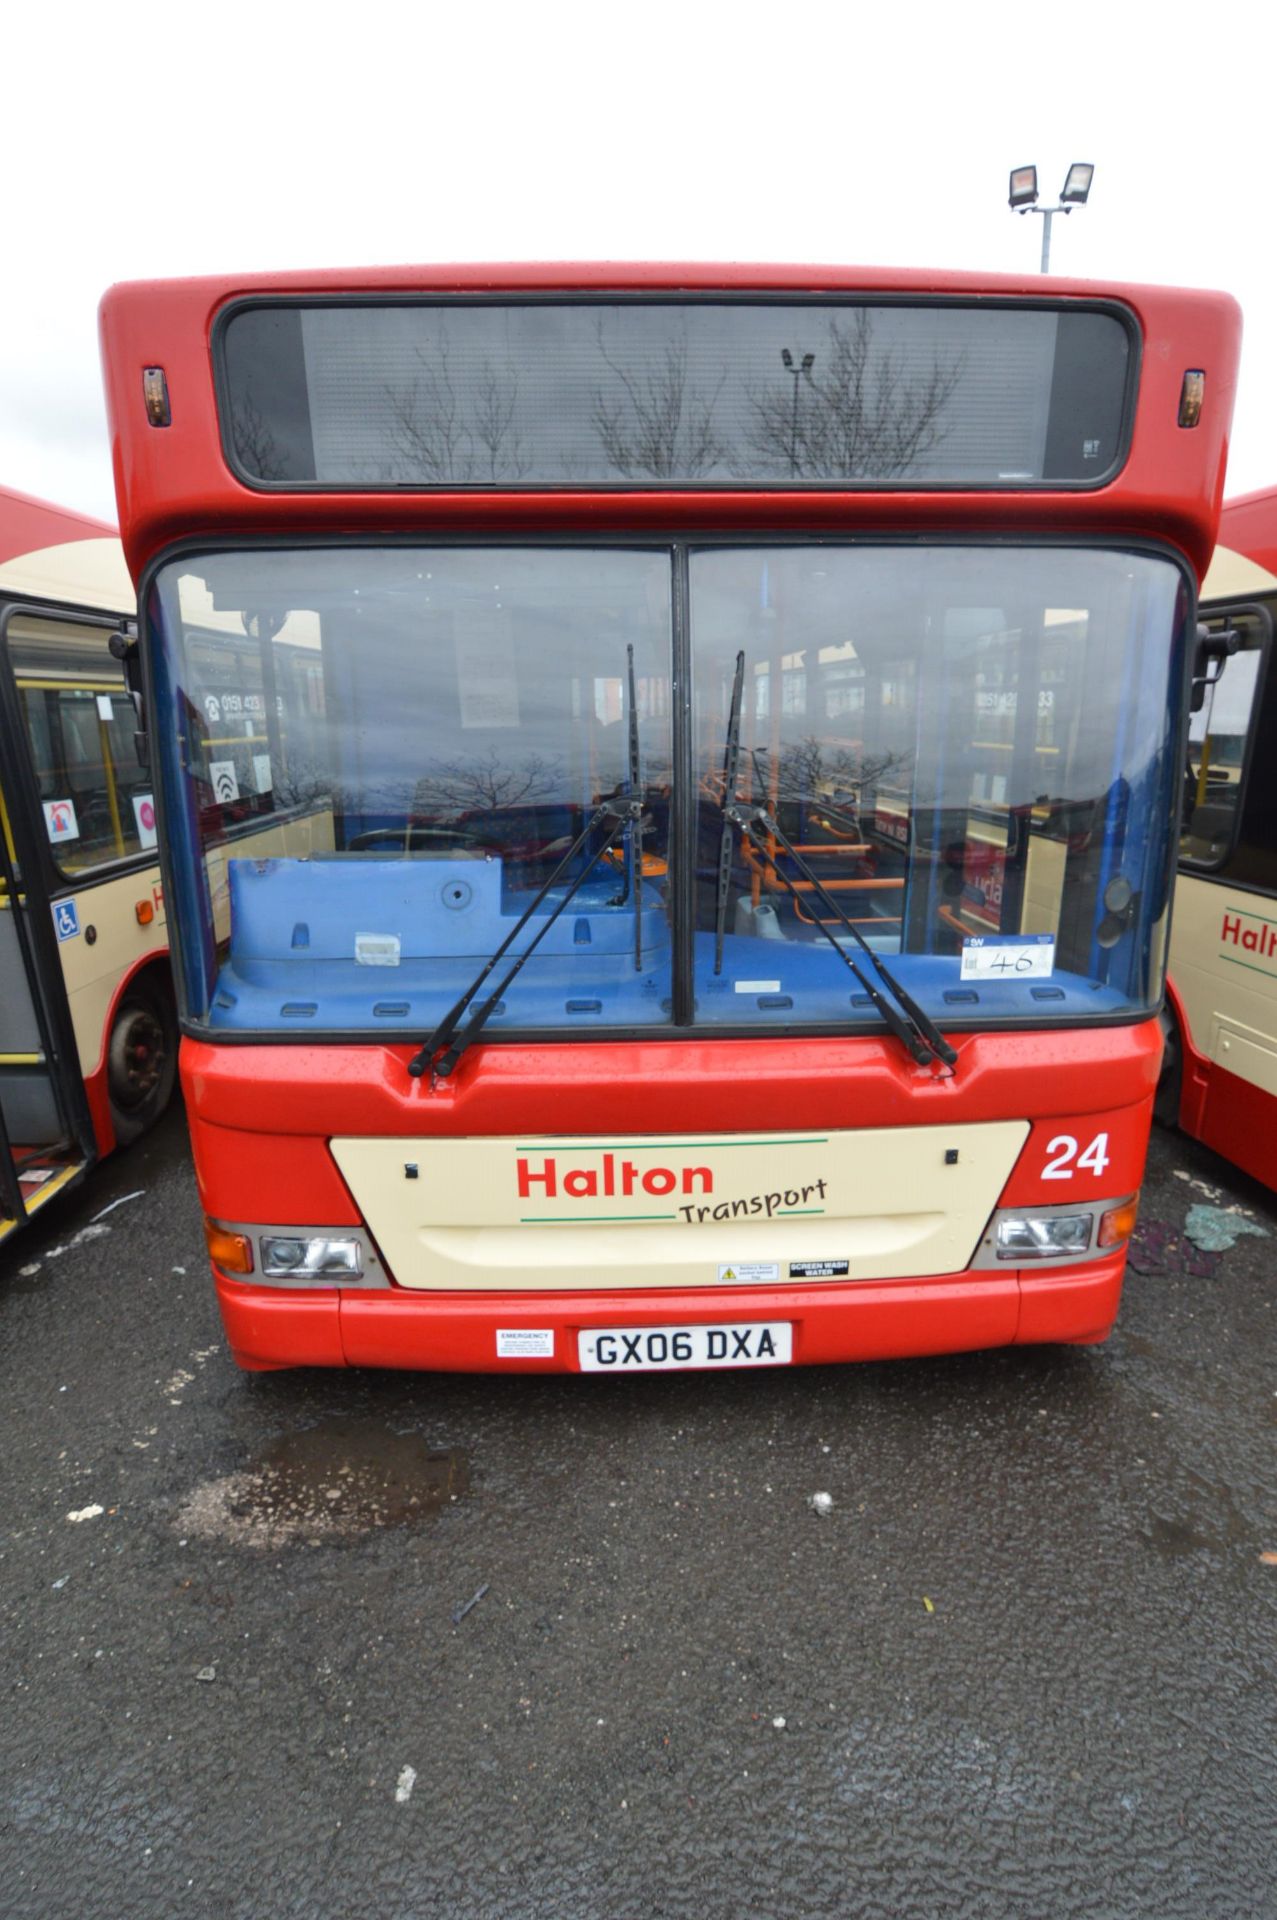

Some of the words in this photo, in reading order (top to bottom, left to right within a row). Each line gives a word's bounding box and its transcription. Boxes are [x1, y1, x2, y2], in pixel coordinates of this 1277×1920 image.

[990, 949, 1032, 973] 46
[1040, 1132, 1110, 1180] 24
[516, 1153, 714, 1198] Halton
[679, 1178, 827, 1223] Transport
[790, 1262, 823, 1271] SCREEN
[824, 1260, 848, 1269] WASH
[805, 1269, 834, 1277] WATER
[596, 1332, 692, 1365] GX06
[706, 1329, 776, 1360] DXA
